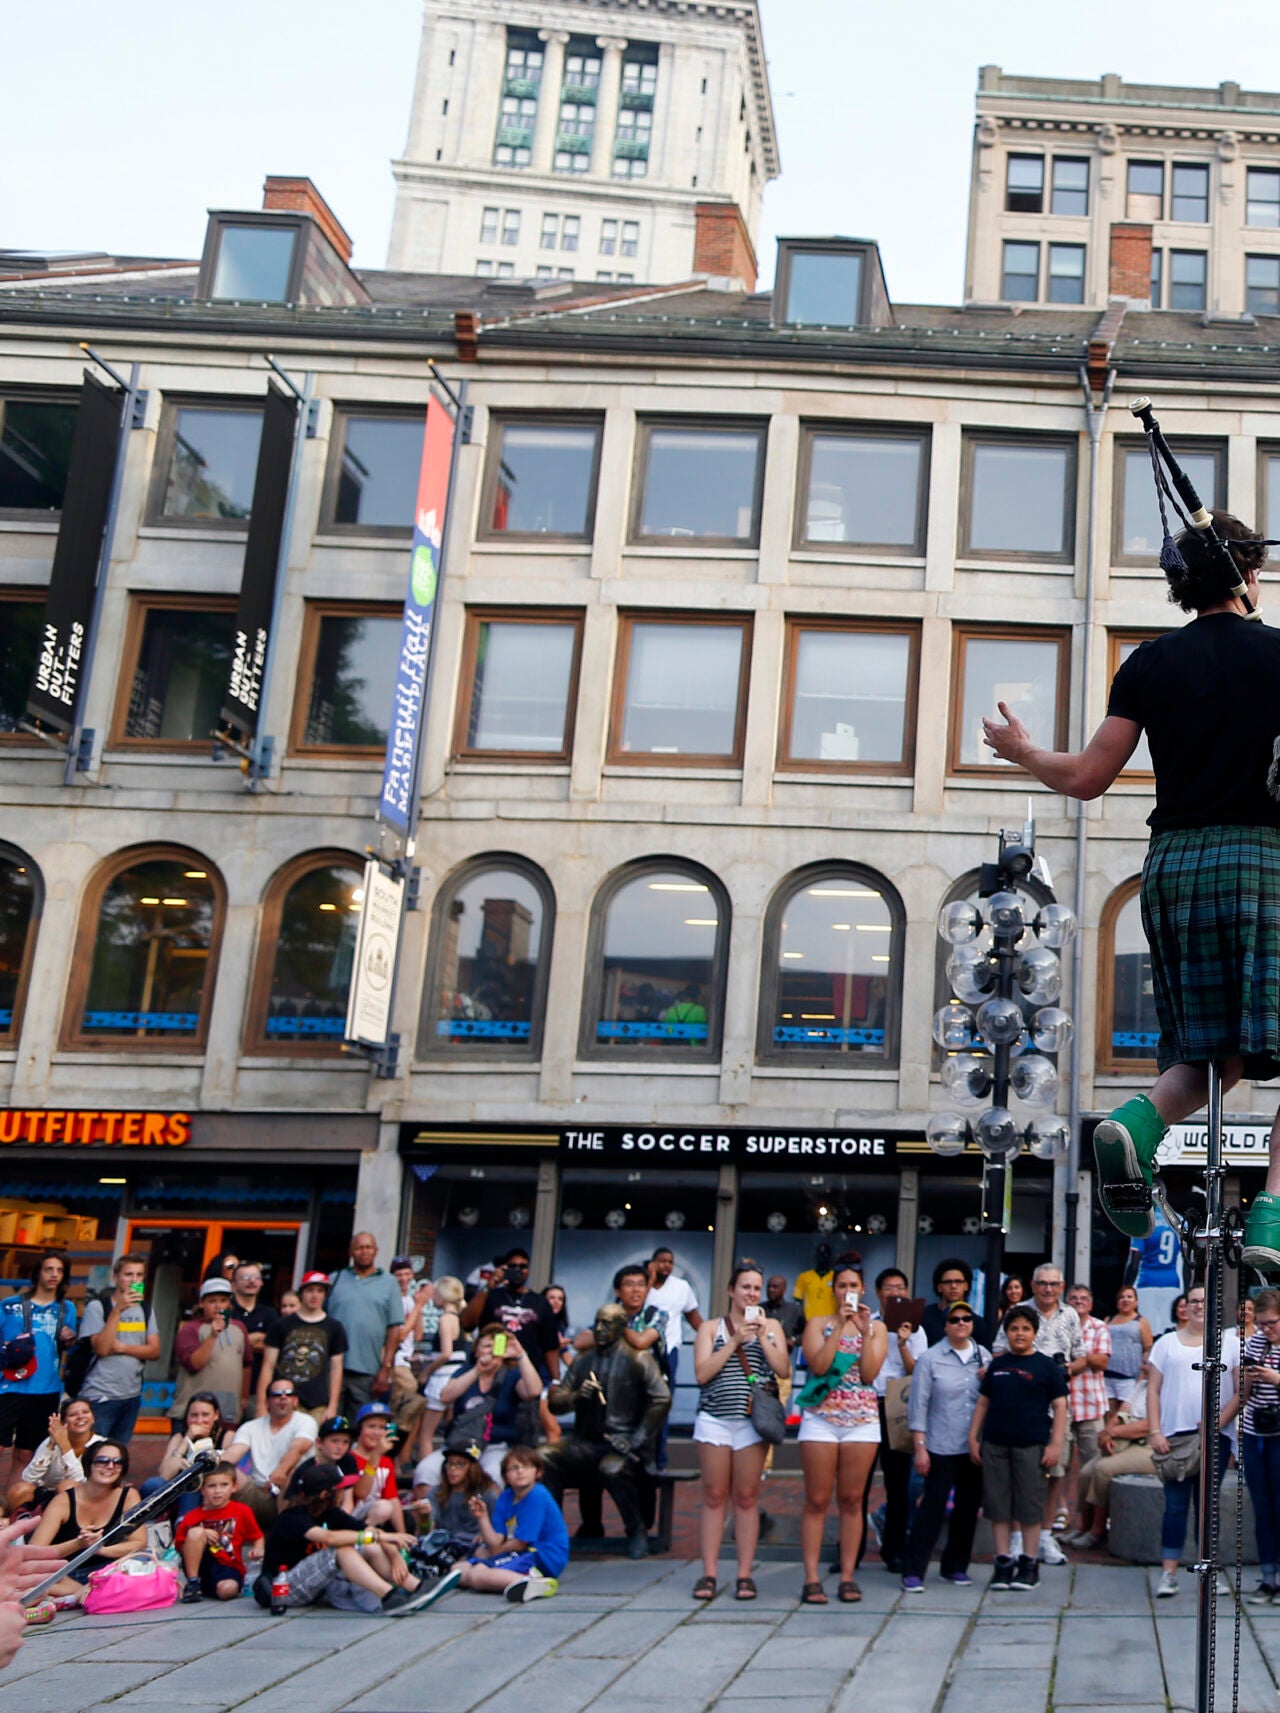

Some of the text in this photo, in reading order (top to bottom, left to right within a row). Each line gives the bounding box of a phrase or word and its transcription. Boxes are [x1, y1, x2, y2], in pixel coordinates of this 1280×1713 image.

[36, 623, 58, 692] URBAN
[60, 621, 84, 706] FITTERS
[228, 630, 248, 698] URBAN
[247, 627, 267, 712] FITTERS
[0, 1111, 191, 1146] UTFITTERS
[565, 1131, 885, 1155] THE SOCCER SUPERSTORE
[1158, 1230, 1175, 1265] 9
